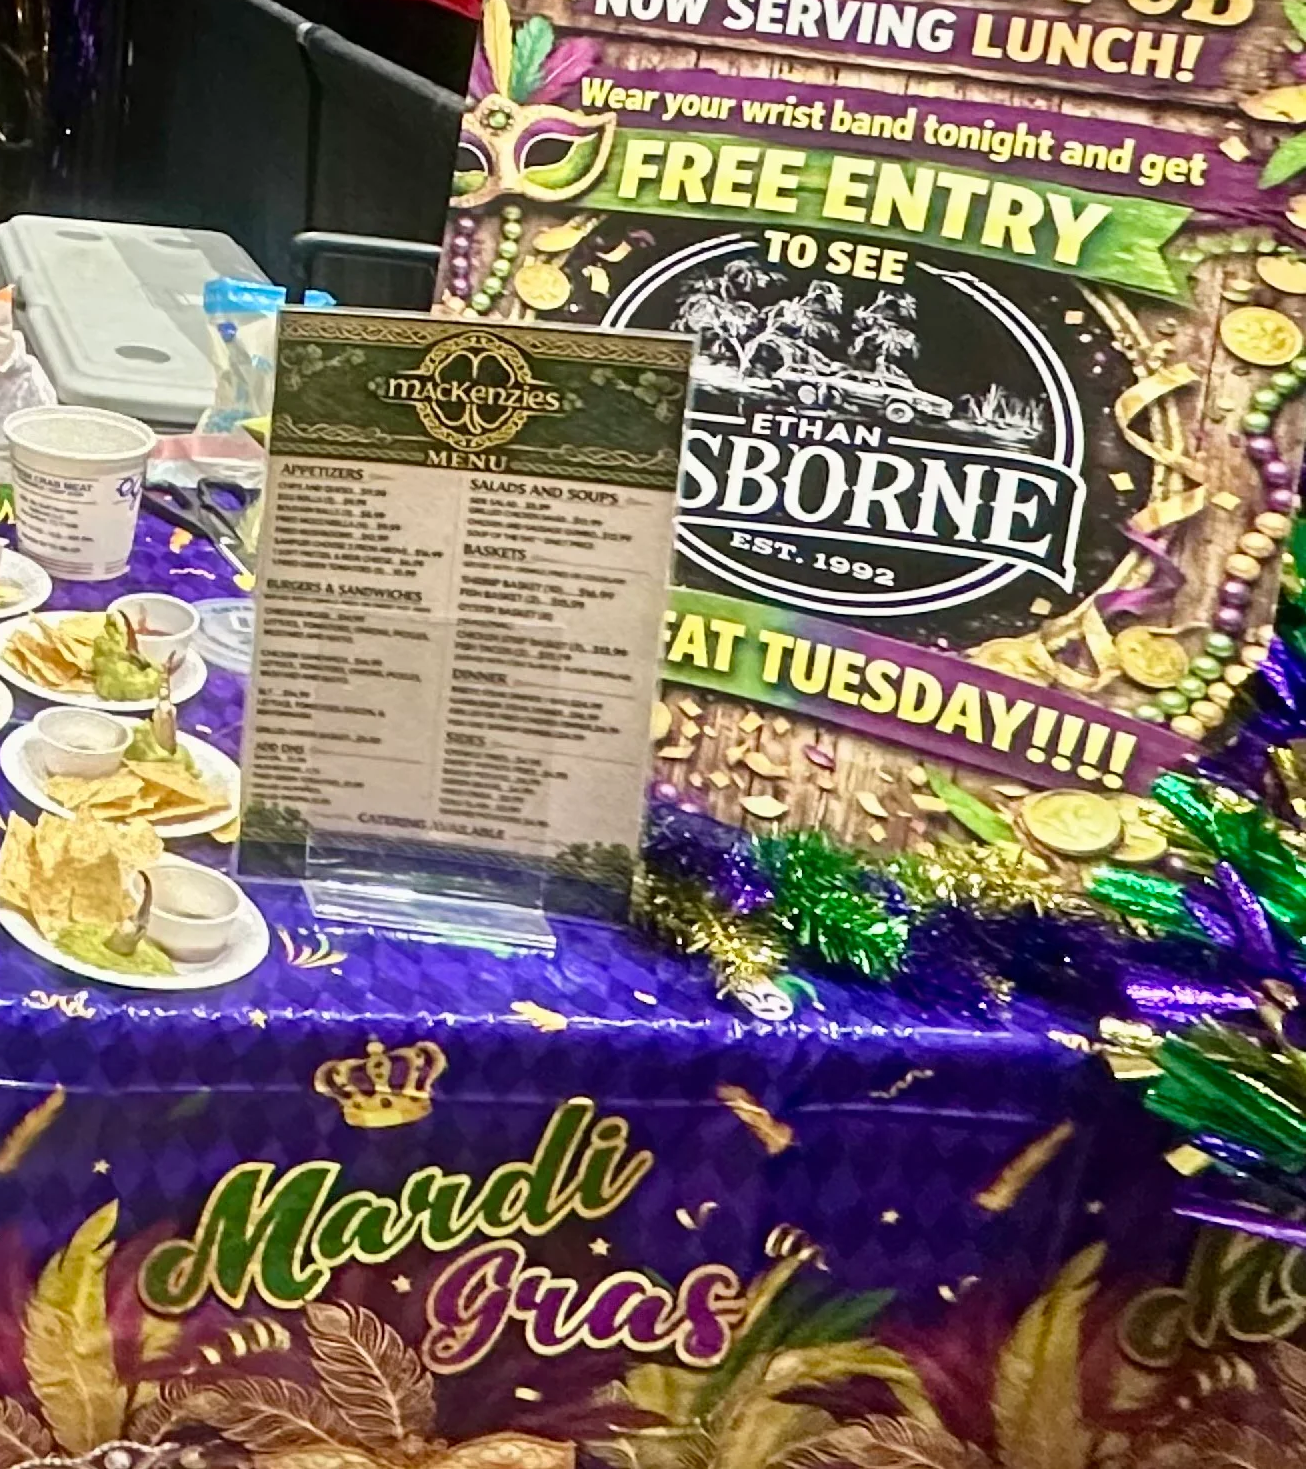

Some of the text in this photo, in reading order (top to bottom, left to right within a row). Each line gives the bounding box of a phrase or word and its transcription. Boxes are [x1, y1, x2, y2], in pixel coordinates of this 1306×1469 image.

[972, 13, 1204, 82] LUNCH!
[581, 77, 1207, 189] Wear your wrist band tonight and get
[616, 139, 1115, 268] FREE ENTRY
[763, 229, 908, 285] TO SEE
[751, 412, 882, 447] ETHAN
[281, 463, 364, 480] APPETIZERS
[426, 449, 508, 471] MENU
[469, 478, 526, 495] SALADS
[529, 485, 563, 498] AND
[567, 489, 619, 505] SOUPS
[679, 426, 1060, 559] SBORNE
[463, 544, 527, 561] BASKETS
[729, 531, 895, 587] EST. 1992
[266, 578, 423, 602] BURGERS & SANDWICHES
[758, 629, 1138, 790] TUESDAY!!!!
[357, 812, 426, 829] CATERING
[138, 1095, 653, 1314] Mardi
[419, 1239, 750, 1374] Gras
